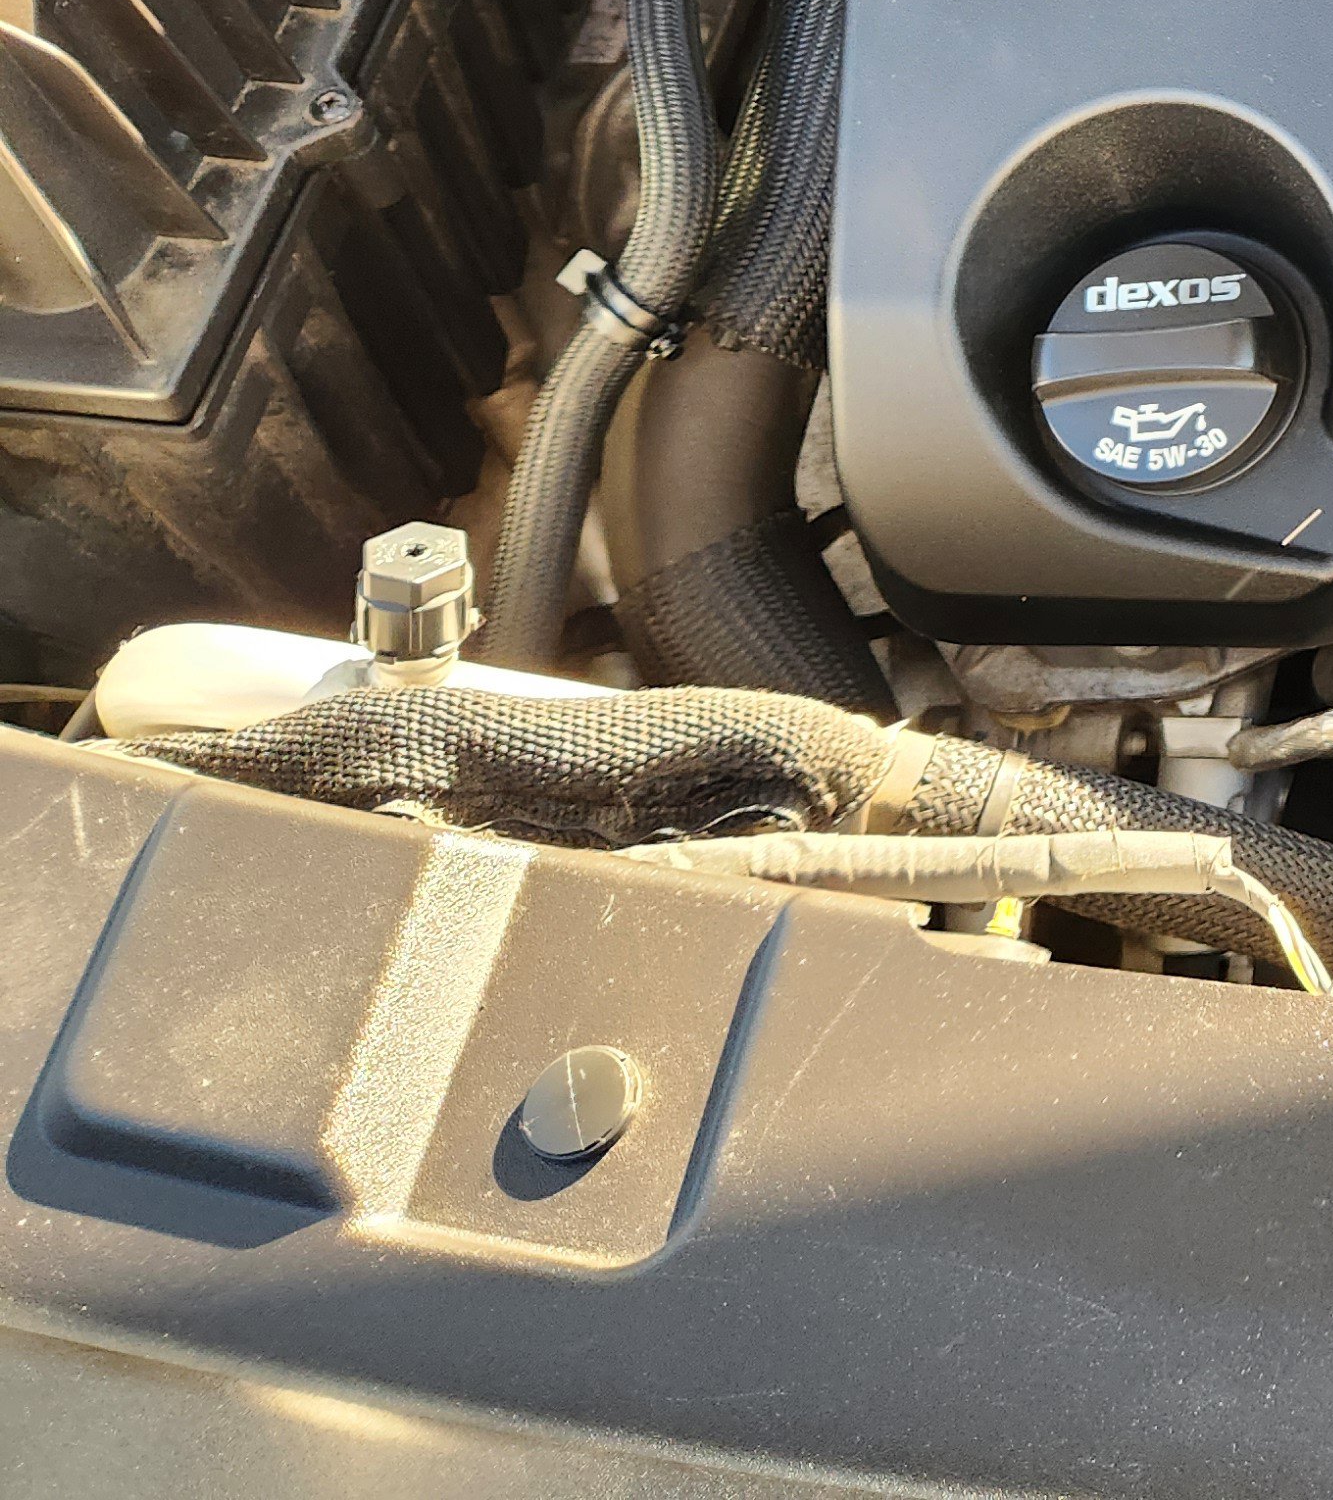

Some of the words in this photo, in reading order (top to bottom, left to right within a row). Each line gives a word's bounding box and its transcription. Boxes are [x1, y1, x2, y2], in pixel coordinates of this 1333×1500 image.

[1084, 273, 1248, 313] dexos
[1094, 437, 1142, 470] SAE
[1147, 428, 1228, 471] 5W-30
